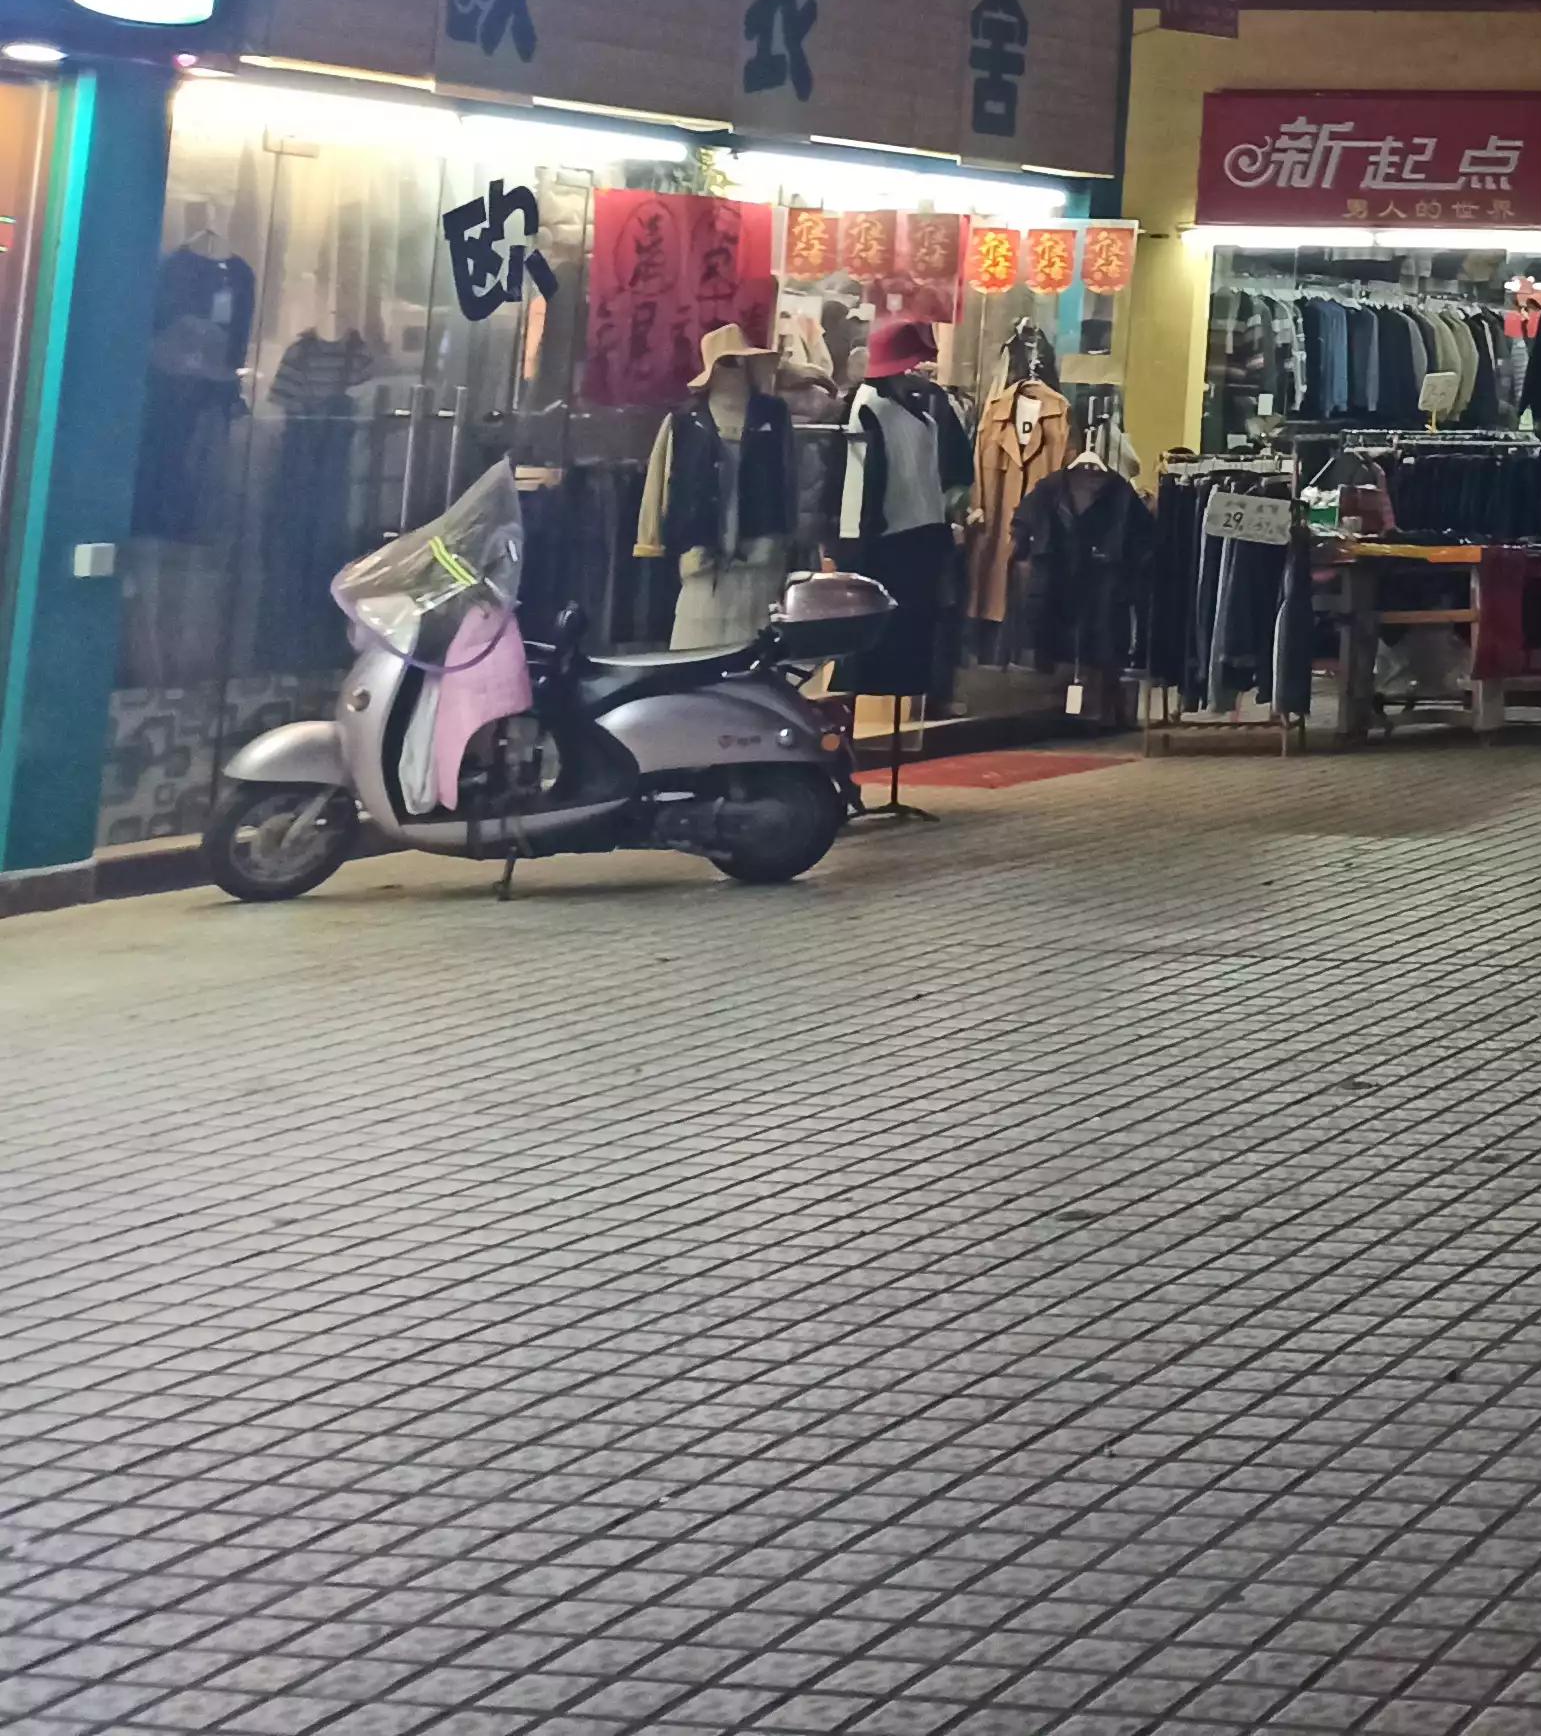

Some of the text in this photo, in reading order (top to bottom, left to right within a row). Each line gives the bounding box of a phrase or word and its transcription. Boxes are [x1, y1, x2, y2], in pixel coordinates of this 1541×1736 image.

[1264, 116, 1525, 191] 新起点
[1342, 197, 1516, 221] 男人的世界
